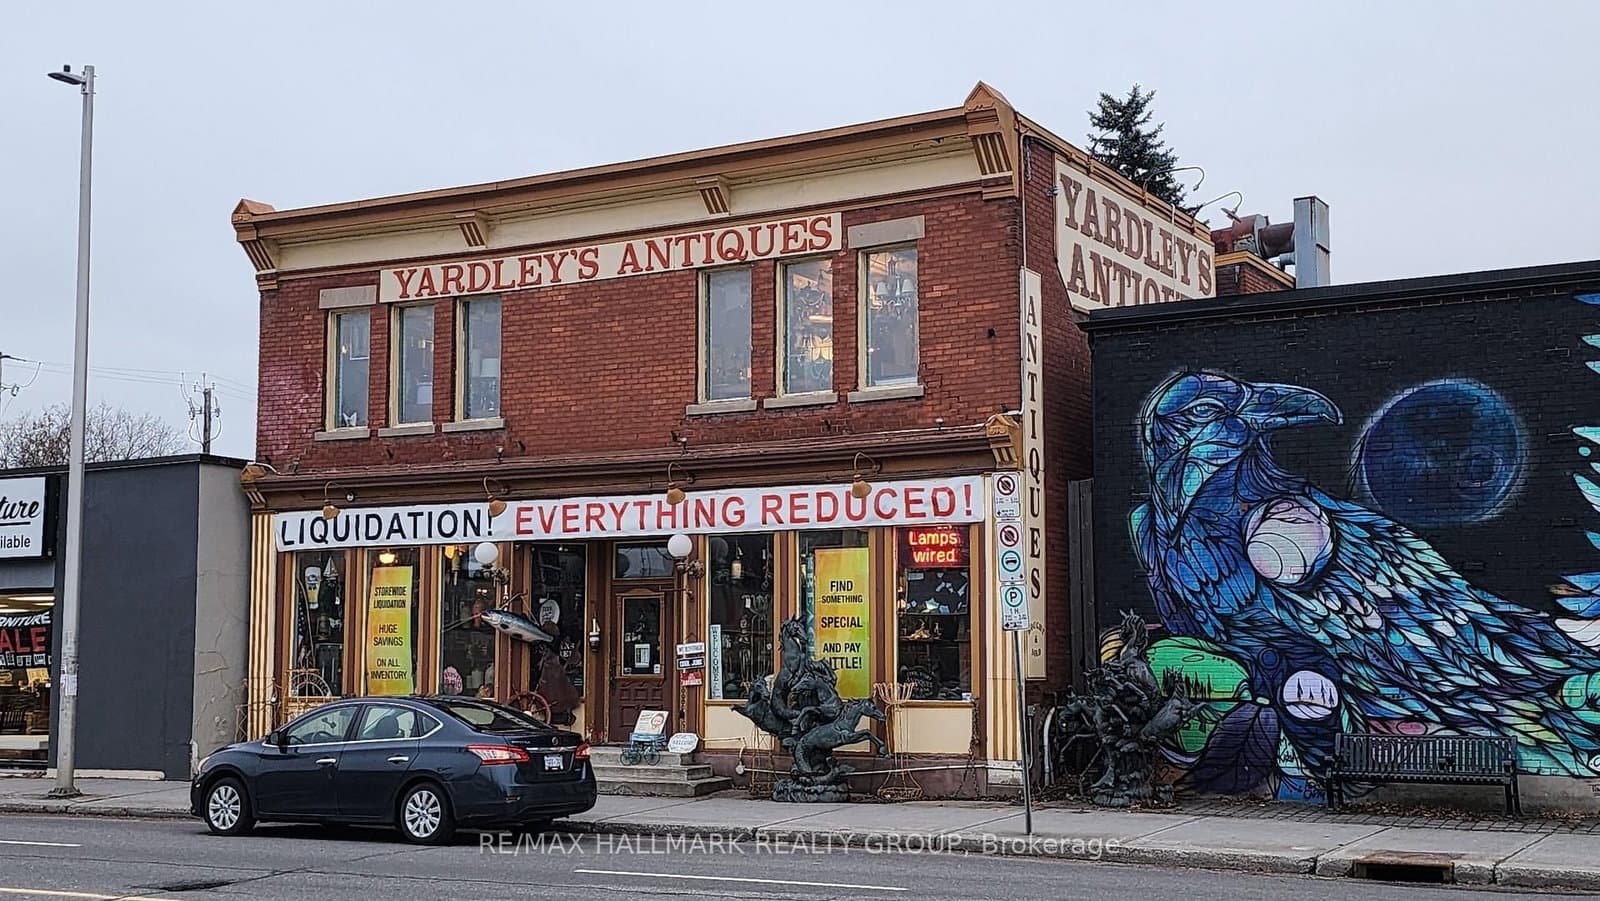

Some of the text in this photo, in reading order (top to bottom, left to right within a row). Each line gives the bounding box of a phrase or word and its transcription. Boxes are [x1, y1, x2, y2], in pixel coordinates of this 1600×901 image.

[1059, 172, 1212, 296] YARDLEY'S
[393, 216, 833, 299] YARDLEY'S ANTIQUES
[1026, 295, 1041, 600] ANTIQUES
[281, 483, 973, 547] LIQUIDATION! EVERYTHING REDUCED!
[909, 530, 958, 548] Lamps
[913, 549, 957, 564] wired
[374, 586, 407, 597] STOREWIDE
[830, 580, 853, 592] FIND
[373, 599, 406, 609] LIQUIDATION
[821, 594, 863, 604] SOMETHING
[820, 616, 864, 628] SPECIAL
[378, 624, 398, 634] HUGE
[373, 636, 404, 646] SAVINGS
[822, 642, 861, 653] AND PAY
[376, 657, 400, 667] ON ALL
[824, 657, 862, 669] ITTLE!
[370, 670, 408, 680] INVENTORY
